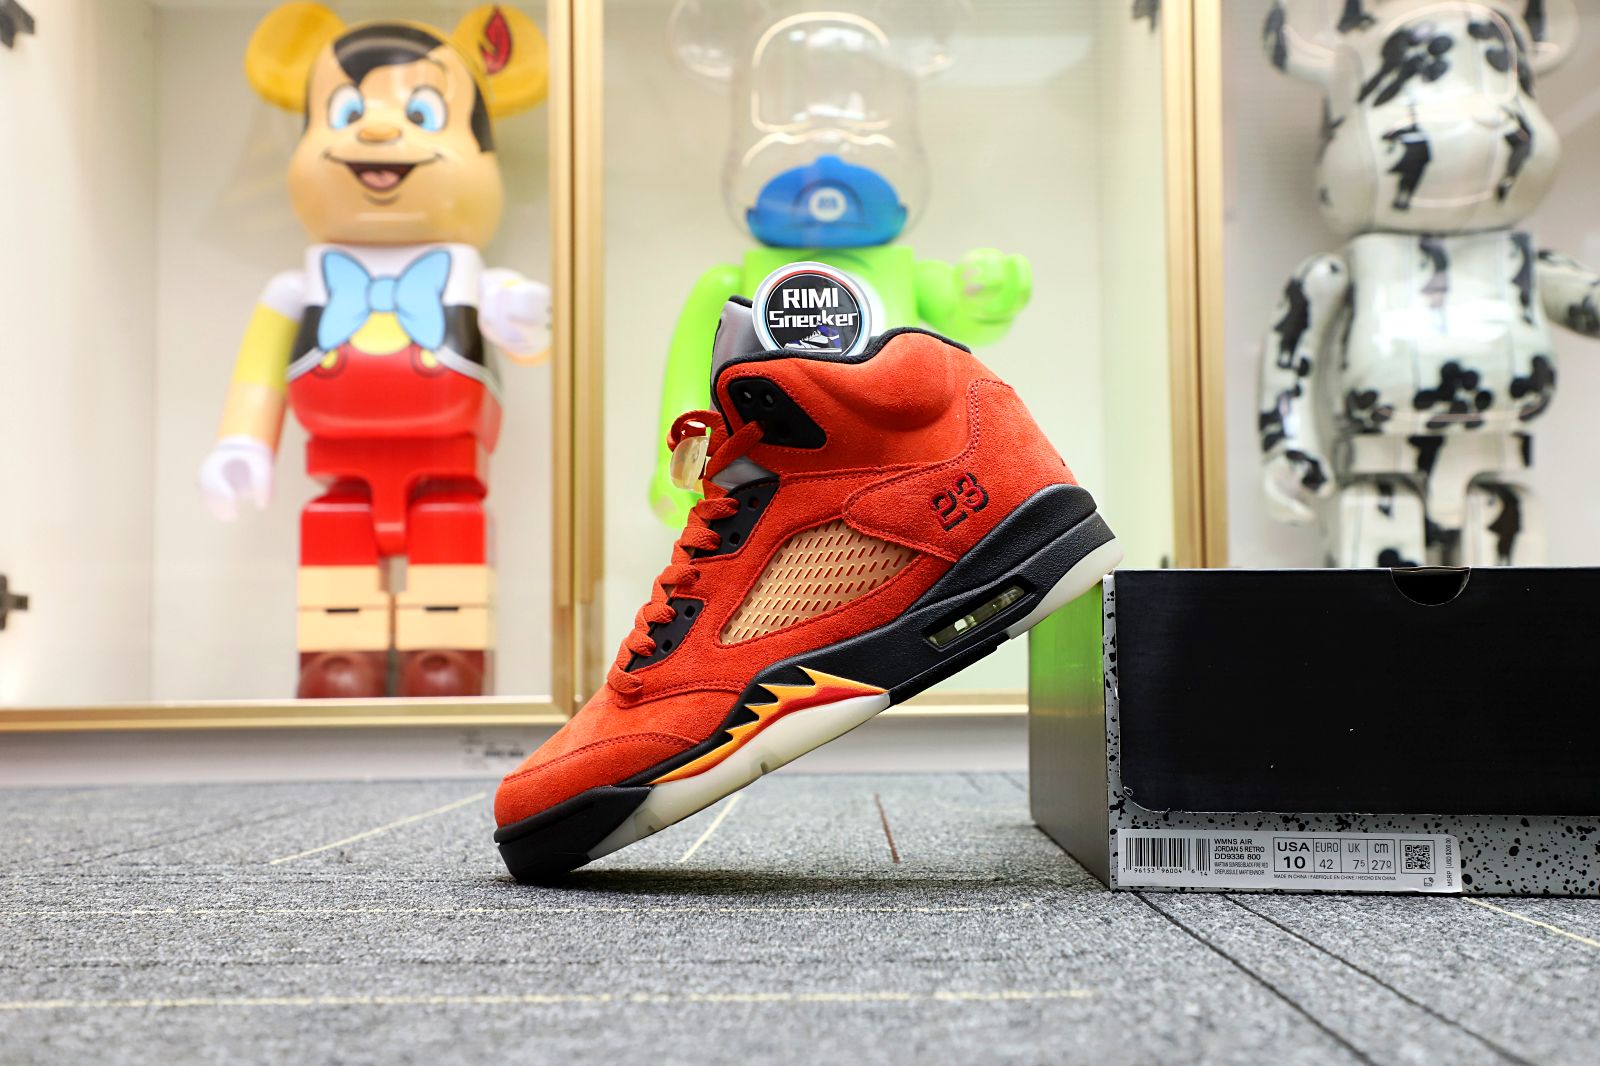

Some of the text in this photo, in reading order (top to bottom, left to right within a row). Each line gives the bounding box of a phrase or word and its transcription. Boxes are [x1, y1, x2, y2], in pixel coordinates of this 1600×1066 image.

[782, 287, 839, 309] RIMI
[769, 310, 858, 328] Sneaker
[929, 472, 989, 532] 23
[1277, 842, 1311, 852] USA
[1315, 842, 1339, 853] EURO
[1348, 843, 1361, 853] UK
[1283, 856, 1306, 869] 10
[1319, 859, 1334, 870] 42
